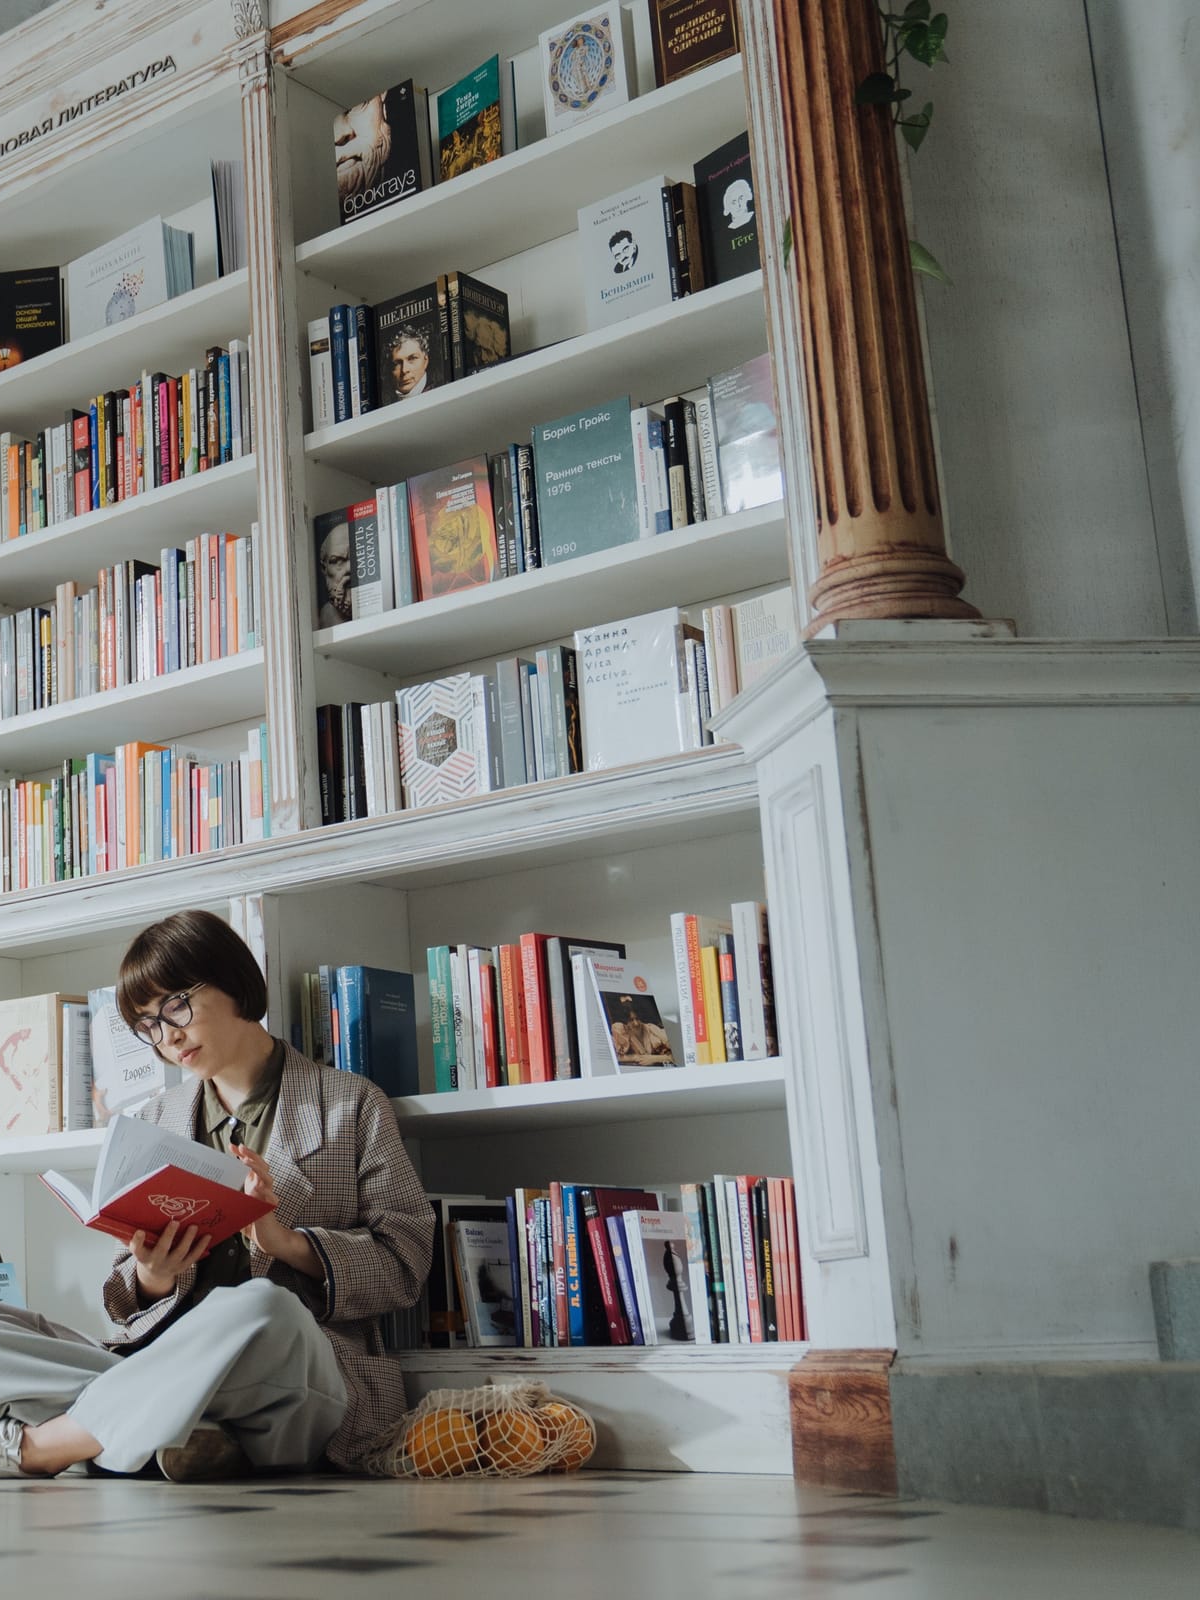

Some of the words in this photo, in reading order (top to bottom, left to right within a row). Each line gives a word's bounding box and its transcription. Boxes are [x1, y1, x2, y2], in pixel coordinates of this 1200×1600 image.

[667, 13, 727, 48] КУЛЬТУРНОЕ
[674, 8, 717, 36] ВЕЛИКОЕ
[673, 25, 724, 54] ОДИЧАНИЕ
[56, 55, 177, 128] ЛИТЕРАТУРА
[456, 91, 472, 105] Тема
[343, 169, 417, 216] брокгауз
[731, 232, 754, 251] Гёте
[600, 272, 654, 300] Беньямин
[15, 307, 42, 316] ОСНОВЫ
[15, 321, 55, 330] ПСИХОЛОГИИ
[379, 297, 433, 329] ШЕЛЛИНГ
[439, 306, 448, 333] КАНТ
[542, 422, 577, 441] Борис
[578, 411, 611, 432] Гройс
[545, 463, 584, 482] Ранние
[586, 452, 622, 473] тексты
[546, 481, 572, 497] 1976
[356, 526, 366, 579] СМЕРТЬ
[366, 523, 376, 576] СОКРАТА
[551, 542, 577, 558] 1990
[583, 629, 628, 645] Ханна
[585, 659, 612, 671] Vita
[431, 978, 442, 1044] Блаженные
[438, 983, 449, 1026] похабы
[123, 1062, 152, 1082] Zappos
[640, 1215, 661, 1225] Aragon
[567, 1231, 579, 1276] КЛЕЙН
[556, 1266, 565, 1296] ПУТЬ
